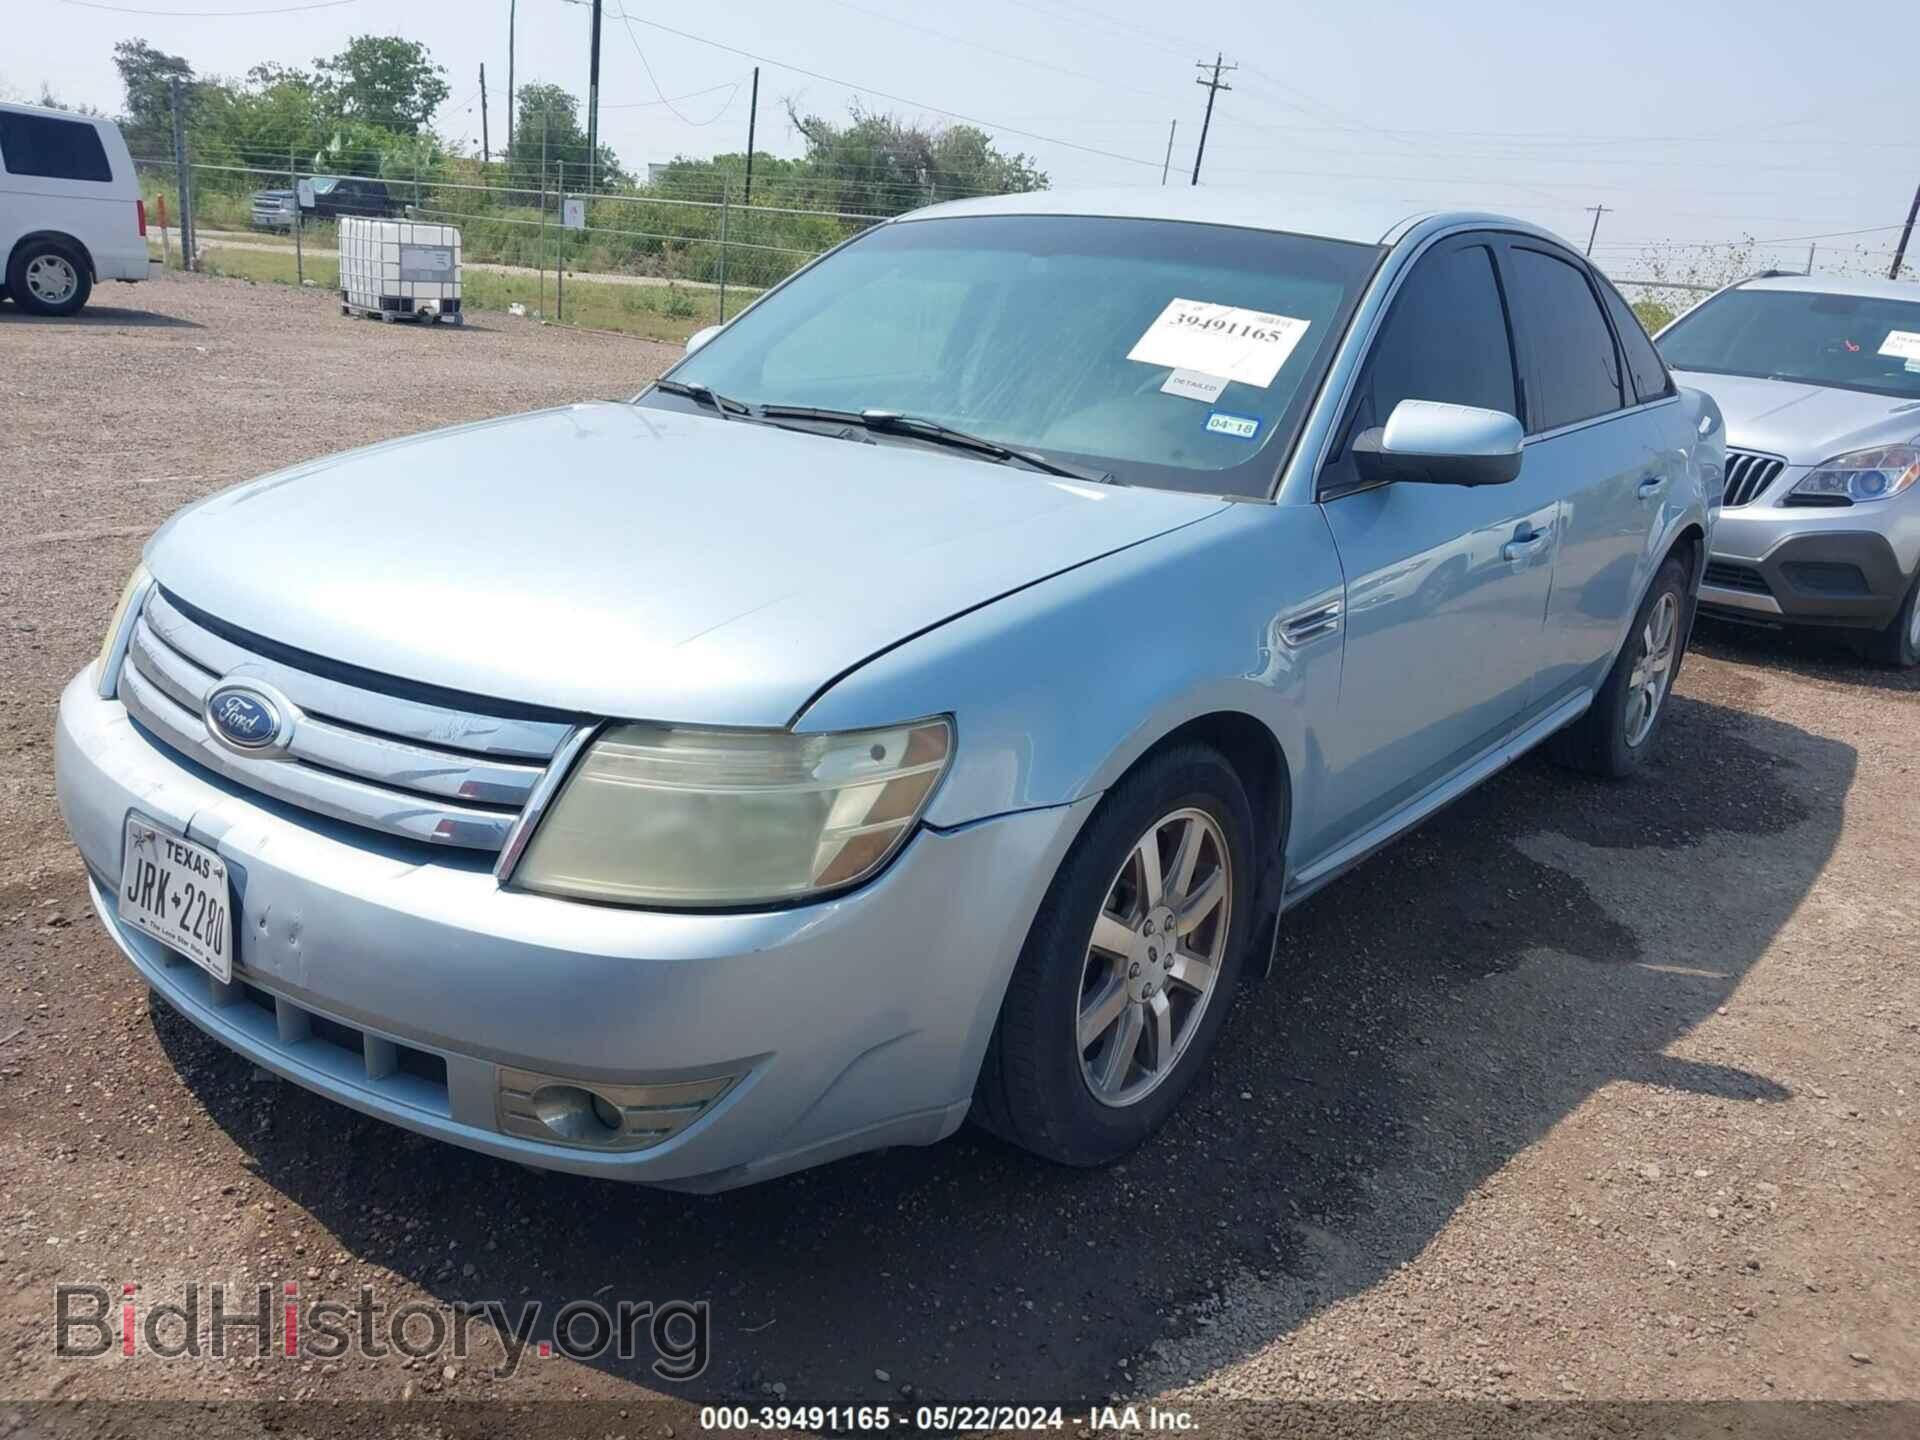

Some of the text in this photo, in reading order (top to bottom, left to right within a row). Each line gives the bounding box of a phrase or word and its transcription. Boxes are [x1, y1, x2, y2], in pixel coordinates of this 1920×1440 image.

[1169, 313, 1282, 342] 39491165
[1173, 377, 1217, 392] DETAILED
[219, 696, 260, 733] Ford
[166, 839, 210, 879] TEXAS
